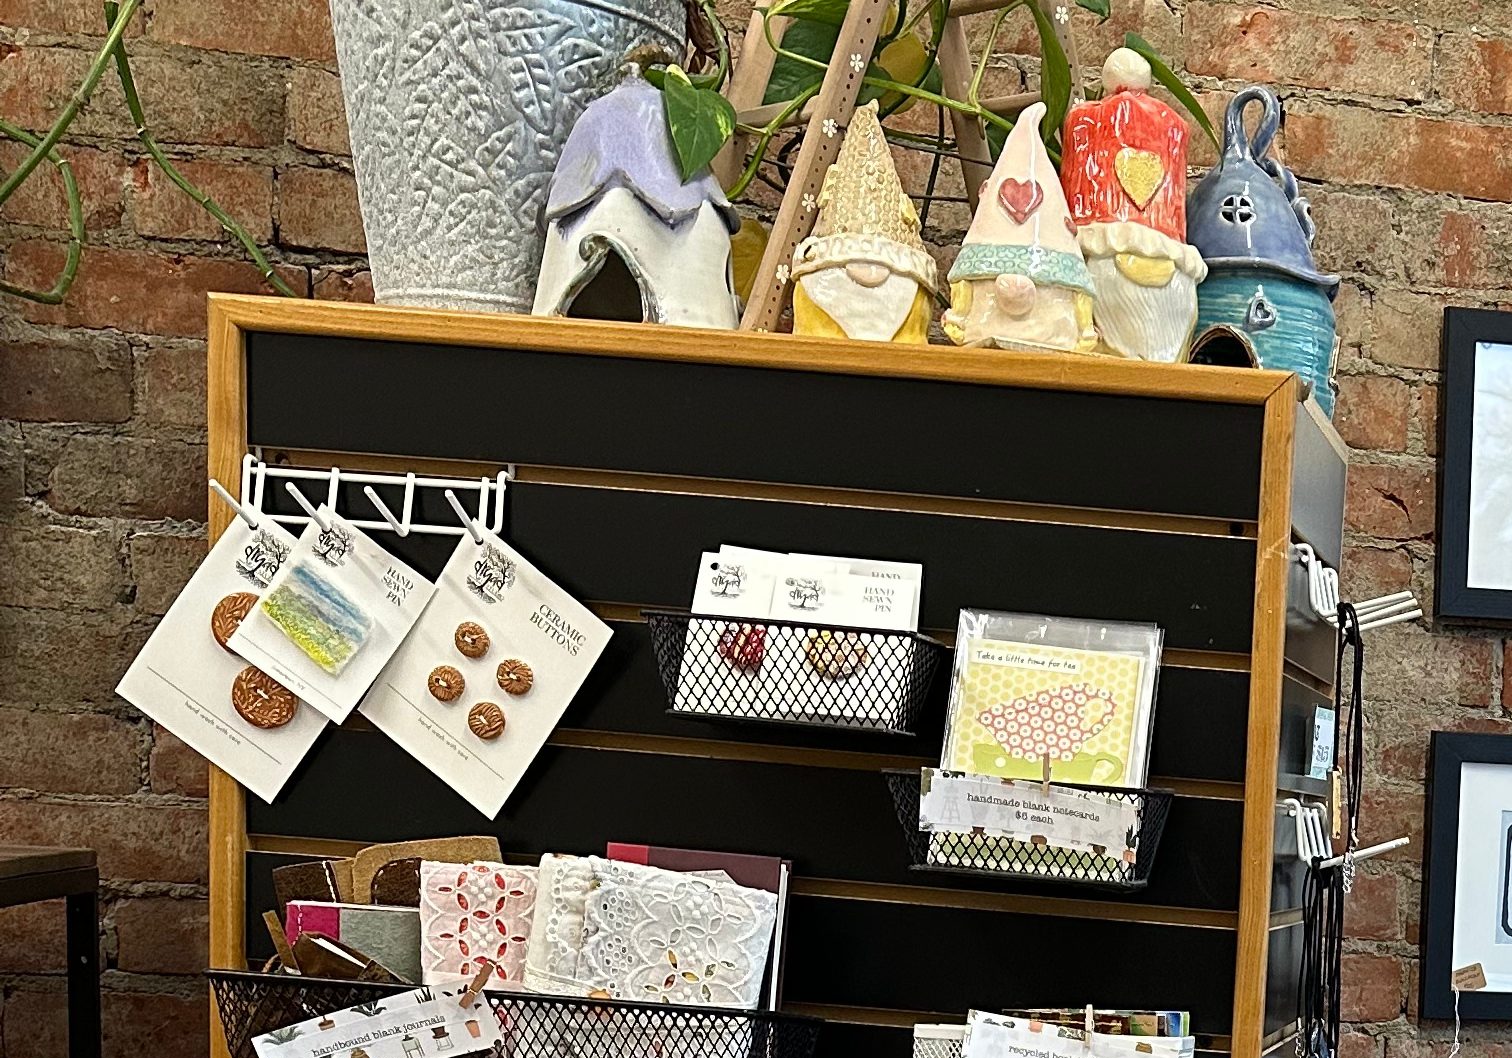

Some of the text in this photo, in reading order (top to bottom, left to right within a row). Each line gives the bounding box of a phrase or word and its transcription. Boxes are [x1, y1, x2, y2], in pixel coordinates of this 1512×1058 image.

[381, 575, 408, 599] SEWN
[387, 566, 414, 591] HAND
[386, 590, 402, 607] PIN
[864, 587, 894, 595] HAND
[875, 604, 891, 613] PIN
[529, 612, 580, 657] BUTTONS
[539, 604, 586, 647] CERAMIC
[977, 651, 994, 660] Take
[1006, 655, 1024, 663] little
[1028, 657, 1045, 666] time
[1048, 659, 1060, 668] for
[1064, 661, 1075, 669] tea
[967, 793, 1100, 822] handmade blank notecards
[1031, 815, 1053, 825] each
[311, 1015, 446, 1057] handbound blank journals
